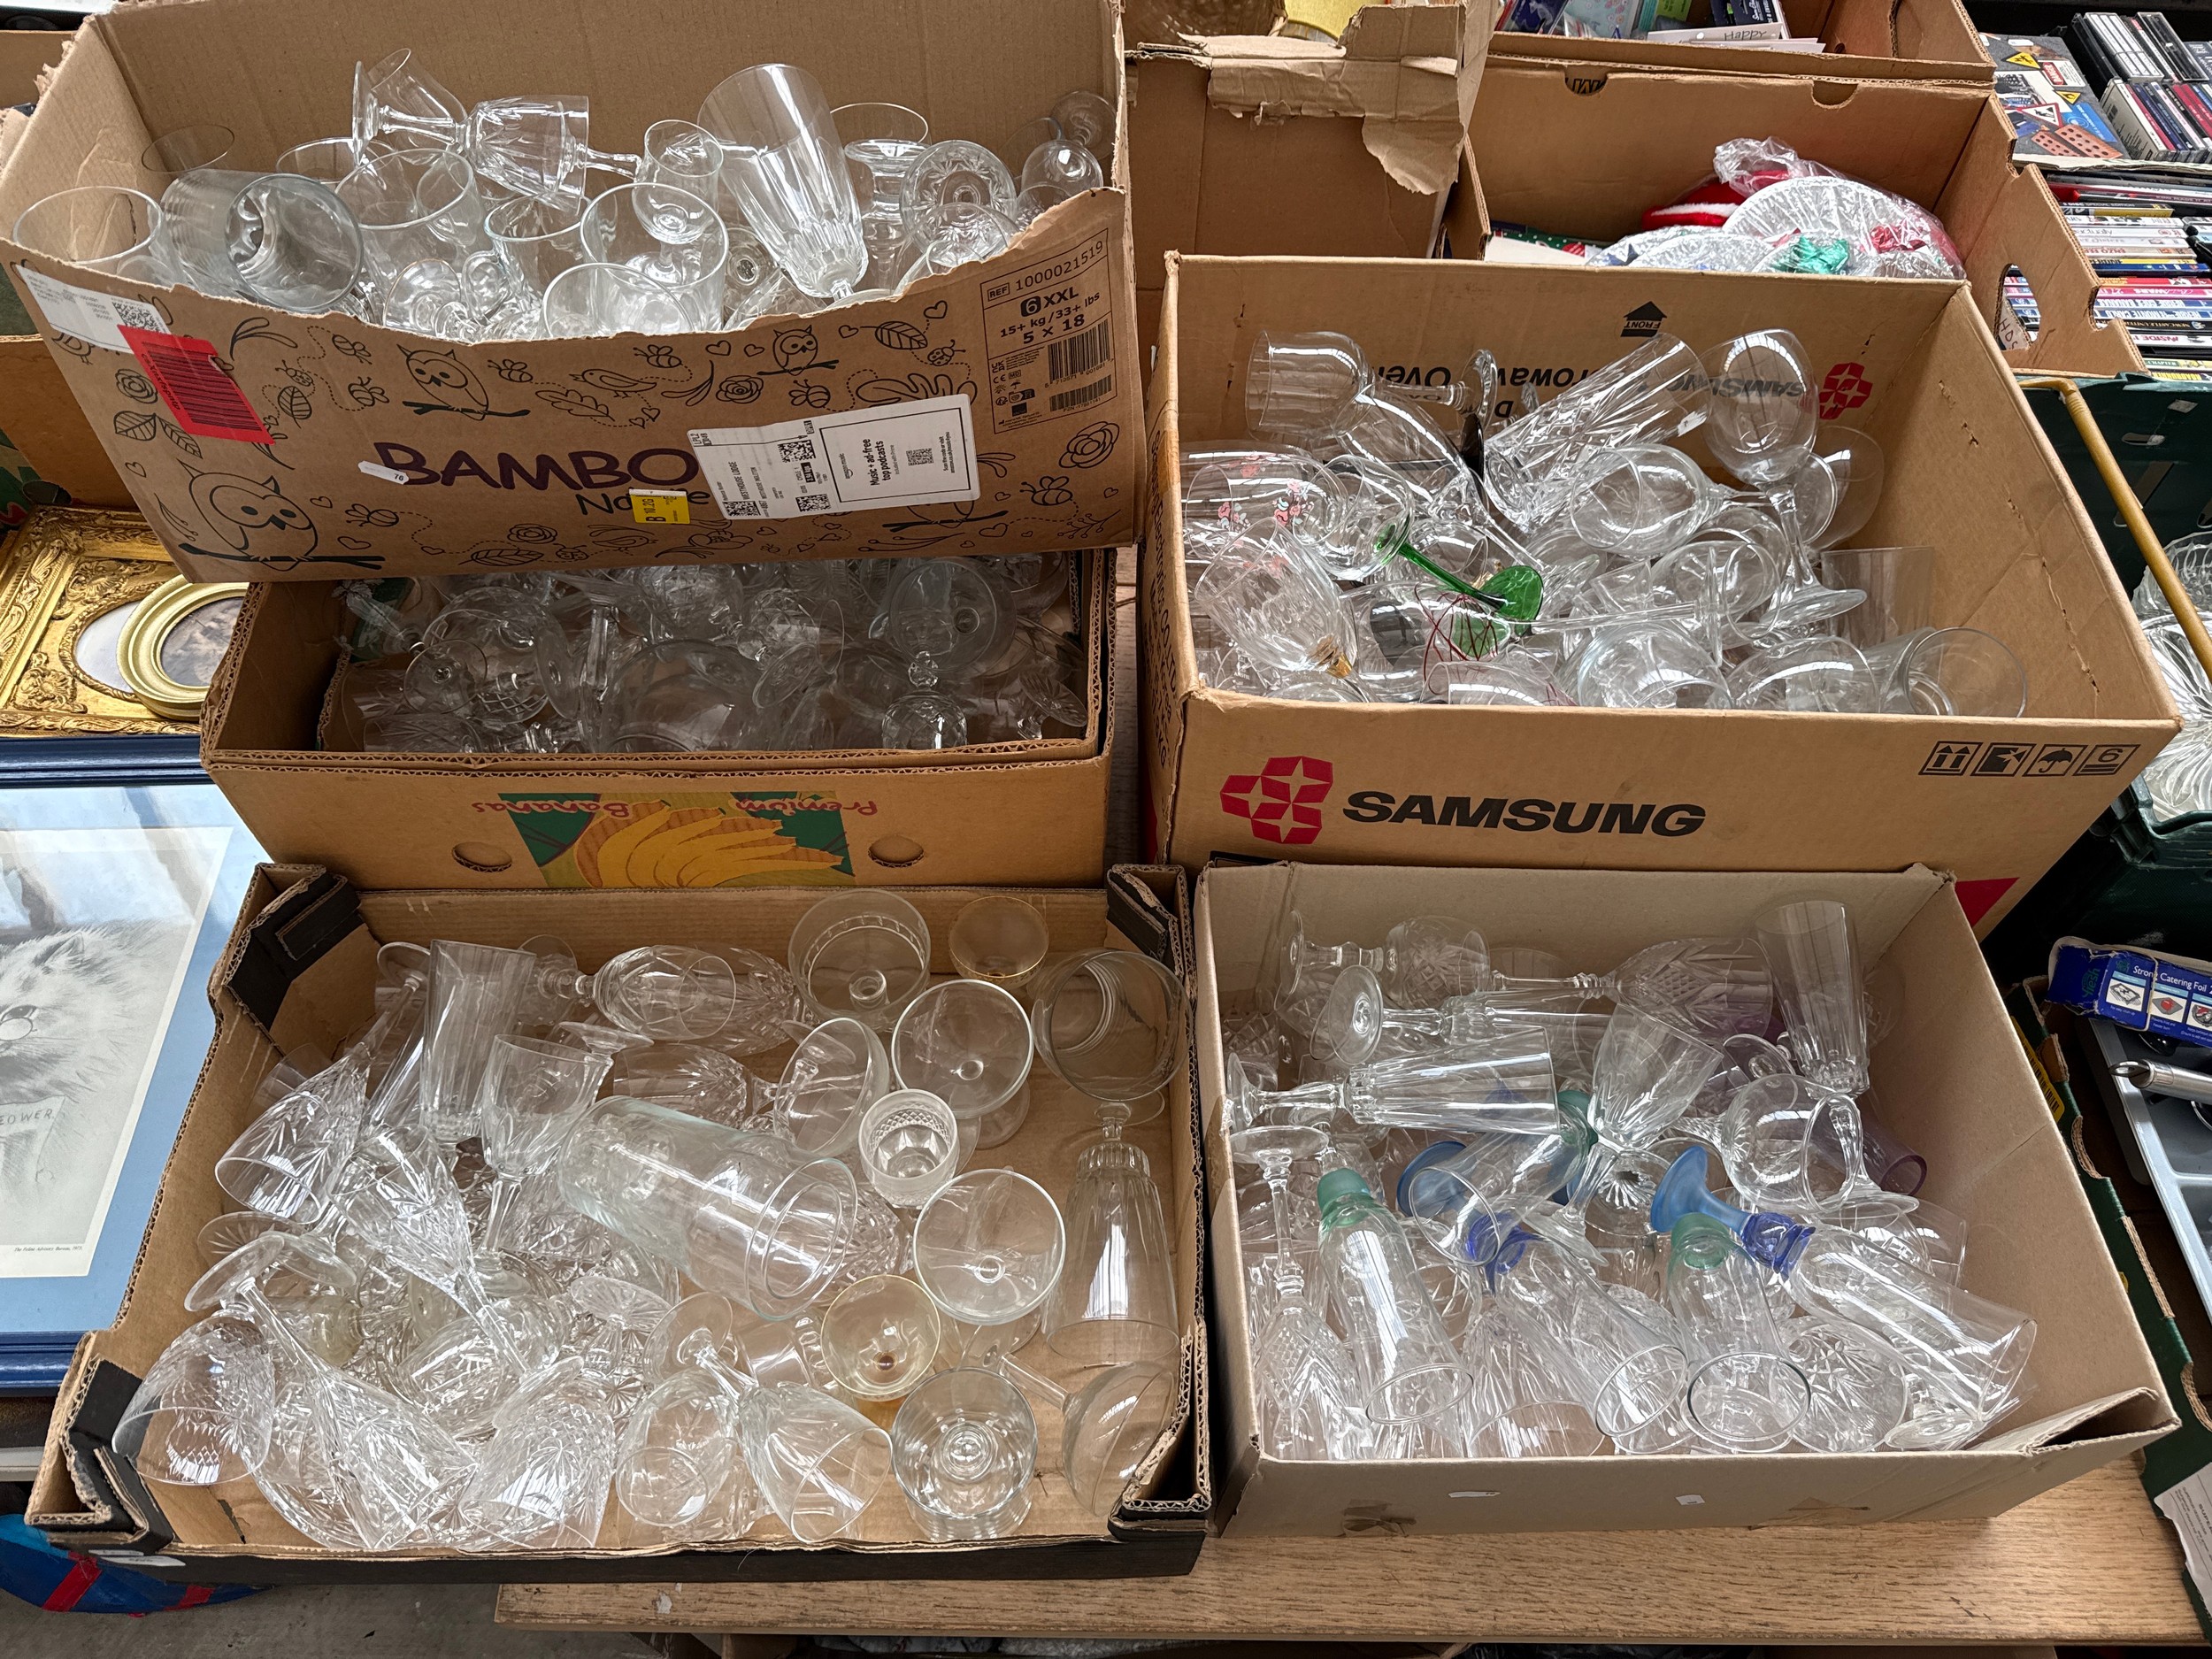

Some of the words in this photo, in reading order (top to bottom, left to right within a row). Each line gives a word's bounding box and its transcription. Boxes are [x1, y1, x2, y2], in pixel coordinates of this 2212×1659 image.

[1724, 29, 1767, 41] Happy
[989, 286, 1008, 298] REF
[1016, 241, 1102, 291] 1000021519
[1043, 287, 1079, 308] XXL
[1001, 324, 1025, 338] 15+
[1084, 292, 1100, 308] lbs
[1624, 320, 1662, 330] FRONT
[1023, 331, 1034, 344] 5
[1062, 313, 1085, 332] 18
[863, 438, 874, 463] ad-free
[876, 441, 891, 470] podcasts
[373, 442, 699, 490] BAMBO
[393, 472, 404, 481] 76
[728, 461, 739, 476] LODGE
[868, 467, 880, 486] Music
[881, 470, 892, 481] top
[734, 476, 750, 500] WESTHOUSE
[1154, 500, 1166, 606] Electronics
[471, 799, 631, 818] Bananas
[735, 797, 879, 817] Premium
[1342, 791, 1707, 836] SAMSUNG
[2132, 965, 2158, 980] Strong
[2160, 972, 2193, 990] Catering
[2193, 981, 2208, 993] Foil
